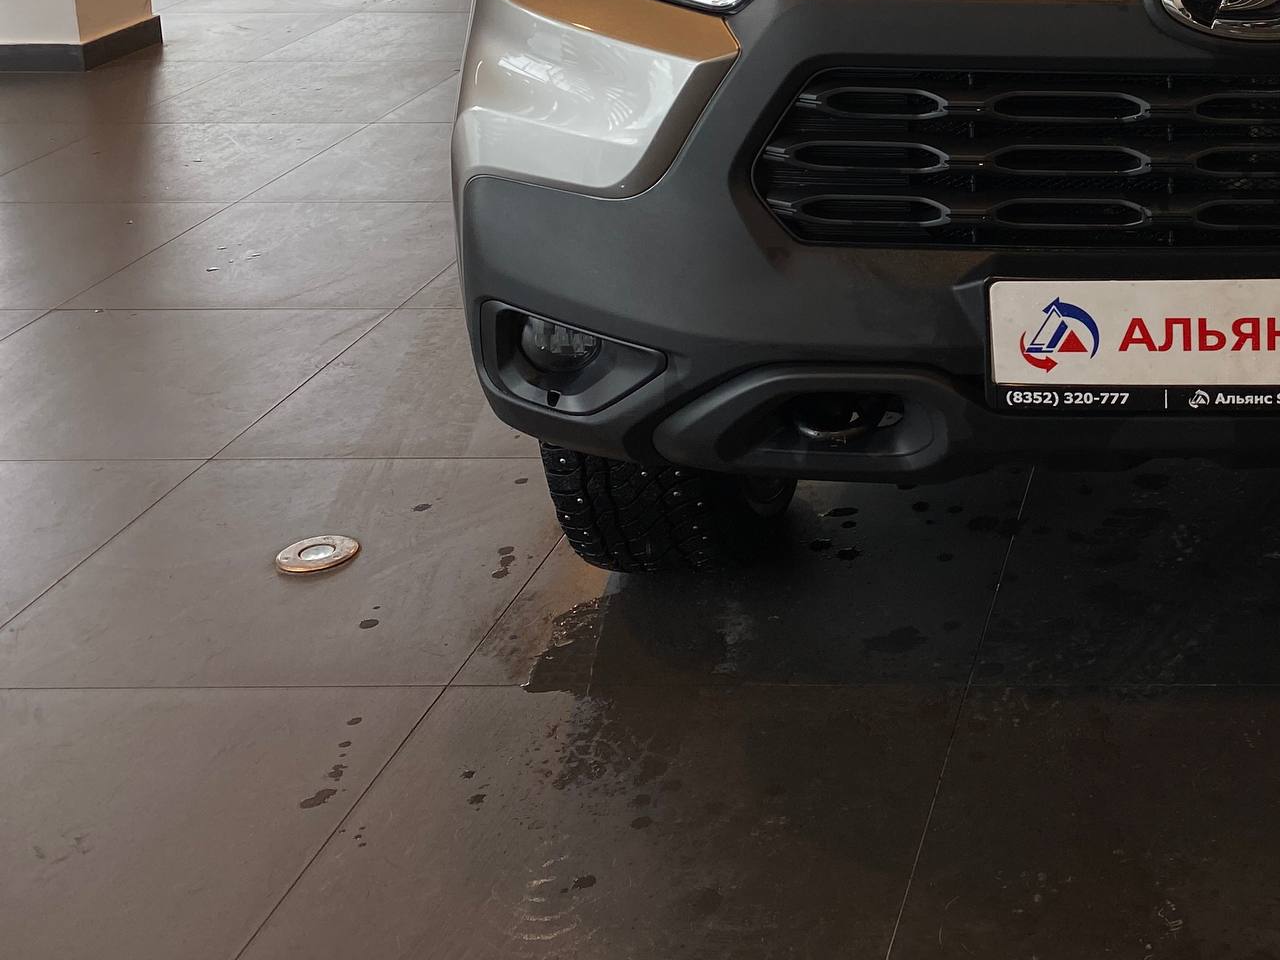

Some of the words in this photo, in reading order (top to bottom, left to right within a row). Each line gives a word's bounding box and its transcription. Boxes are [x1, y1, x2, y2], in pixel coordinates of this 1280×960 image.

[1006, 391, 1060, 407] (8352)
[1063, 392, 1130, 405] 320-777
[1214, 392, 1273, 405] Альянс
